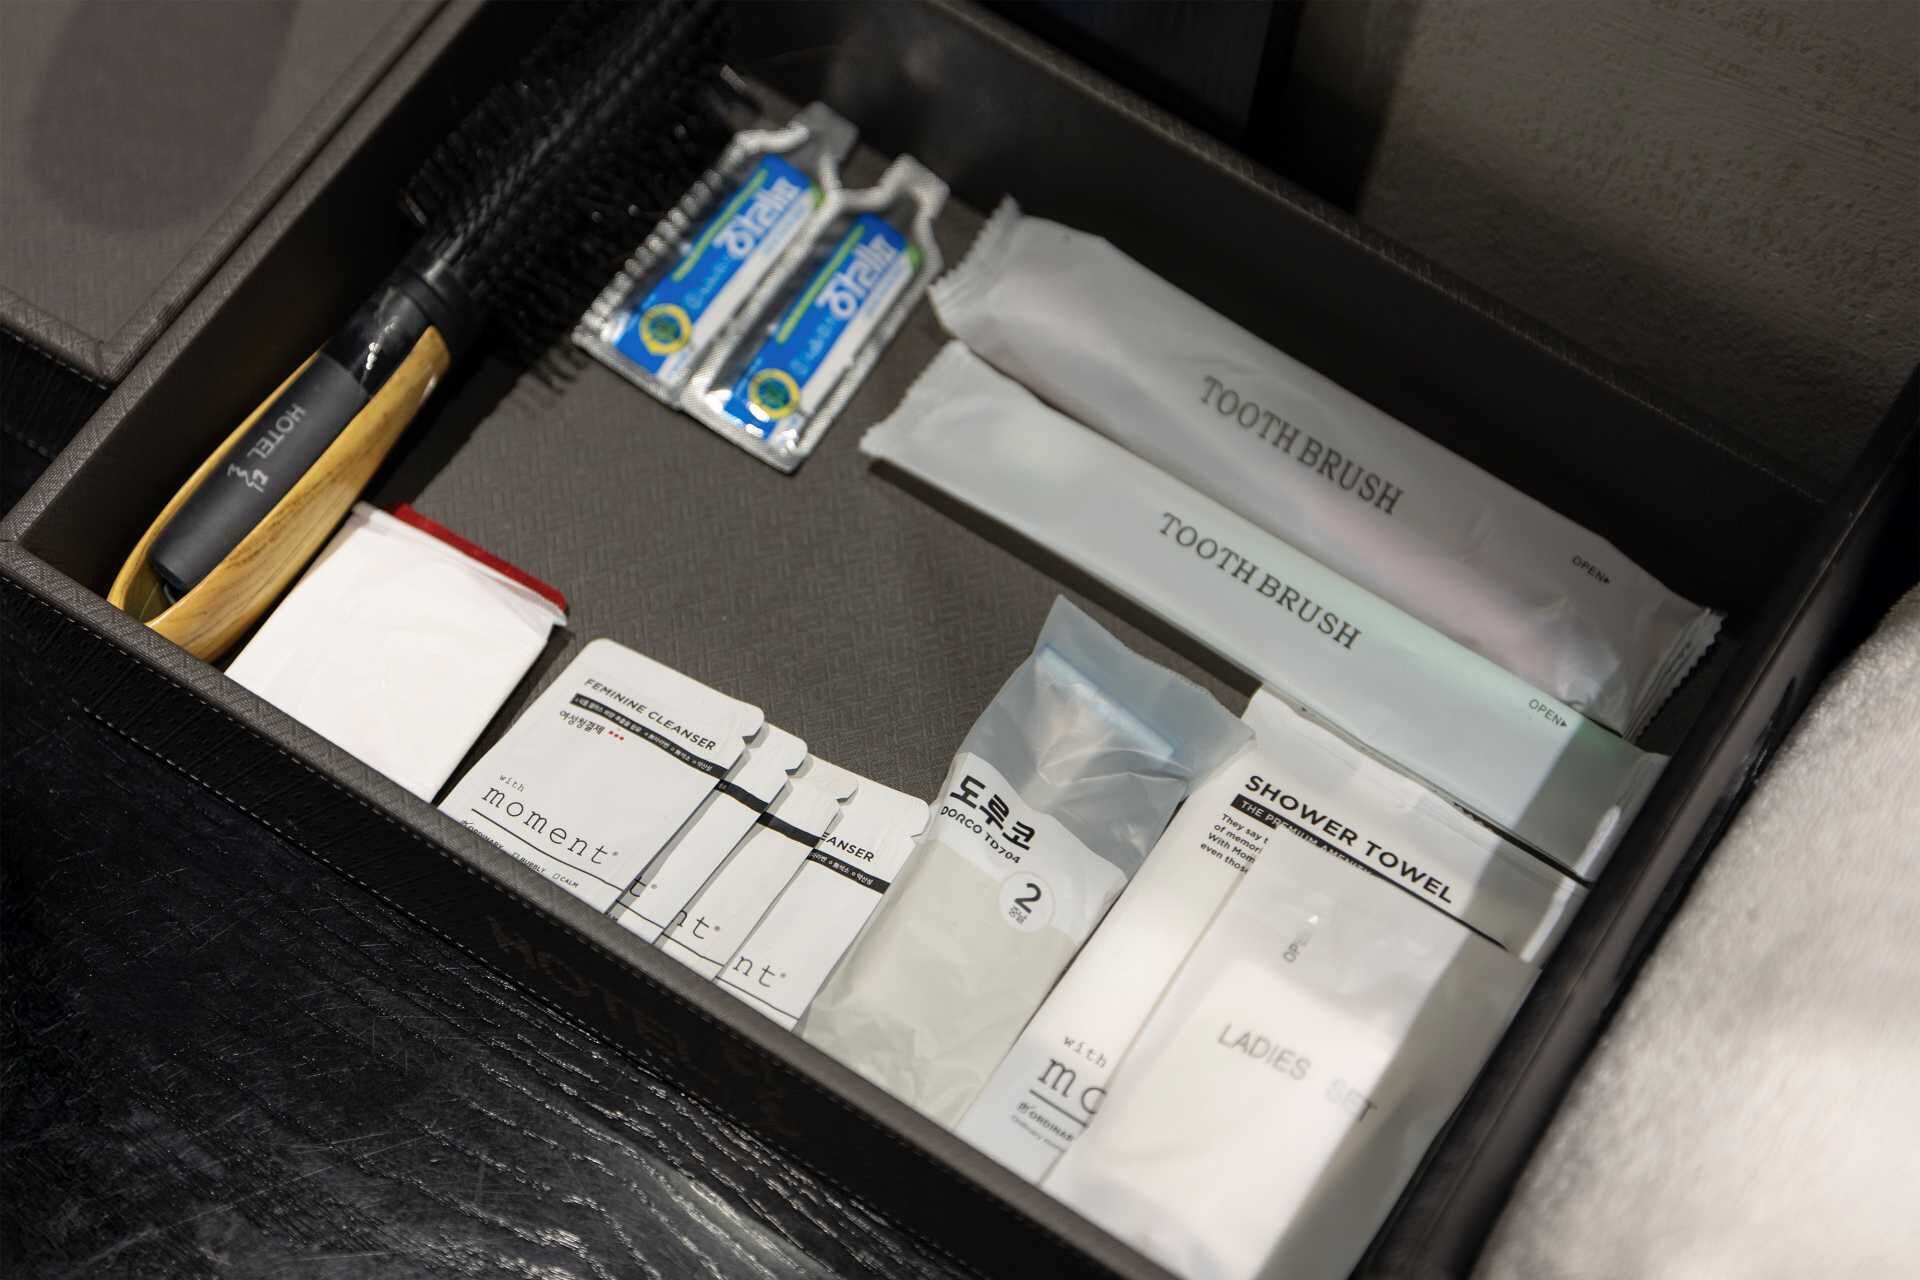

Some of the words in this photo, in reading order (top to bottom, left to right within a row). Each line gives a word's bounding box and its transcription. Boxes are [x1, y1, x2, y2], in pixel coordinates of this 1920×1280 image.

[247, 404, 306, 458] HOTEL
[1572, 555, 1606, 583] OPEN
[1256, 574, 1361, 650] BRUSH
[584, 678, 647, 714] FEMININE
[648, 711, 718, 751] CLEANSER
[1529, 699, 1563, 727] OPEN
[499, 775, 525, 793] with
[950, 775, 1036, 851] 도루코
[1240, 800, 1264, 818] THE
[482, 787, 608, 865] moment
[940, 806, 983, 834] DORCO
[985, 832, 1021, 864] TD704
[1208, 832, 1231, 850] With
[1214, 824, 1227, 833] of
[1222, 814, 1245, 832] They
[1246, 828, 1263, 842] say
[1245, 775, 1358, 847] SHOWER
[1365, 841, 1452, 904] TOWEL
[1200, 843, 1223, 859] even
[1014, 883, 1042, 914] 2
[1063, 1036, 1107, 1069] with
[1217, 1022, 1313, 1081] LADIES
